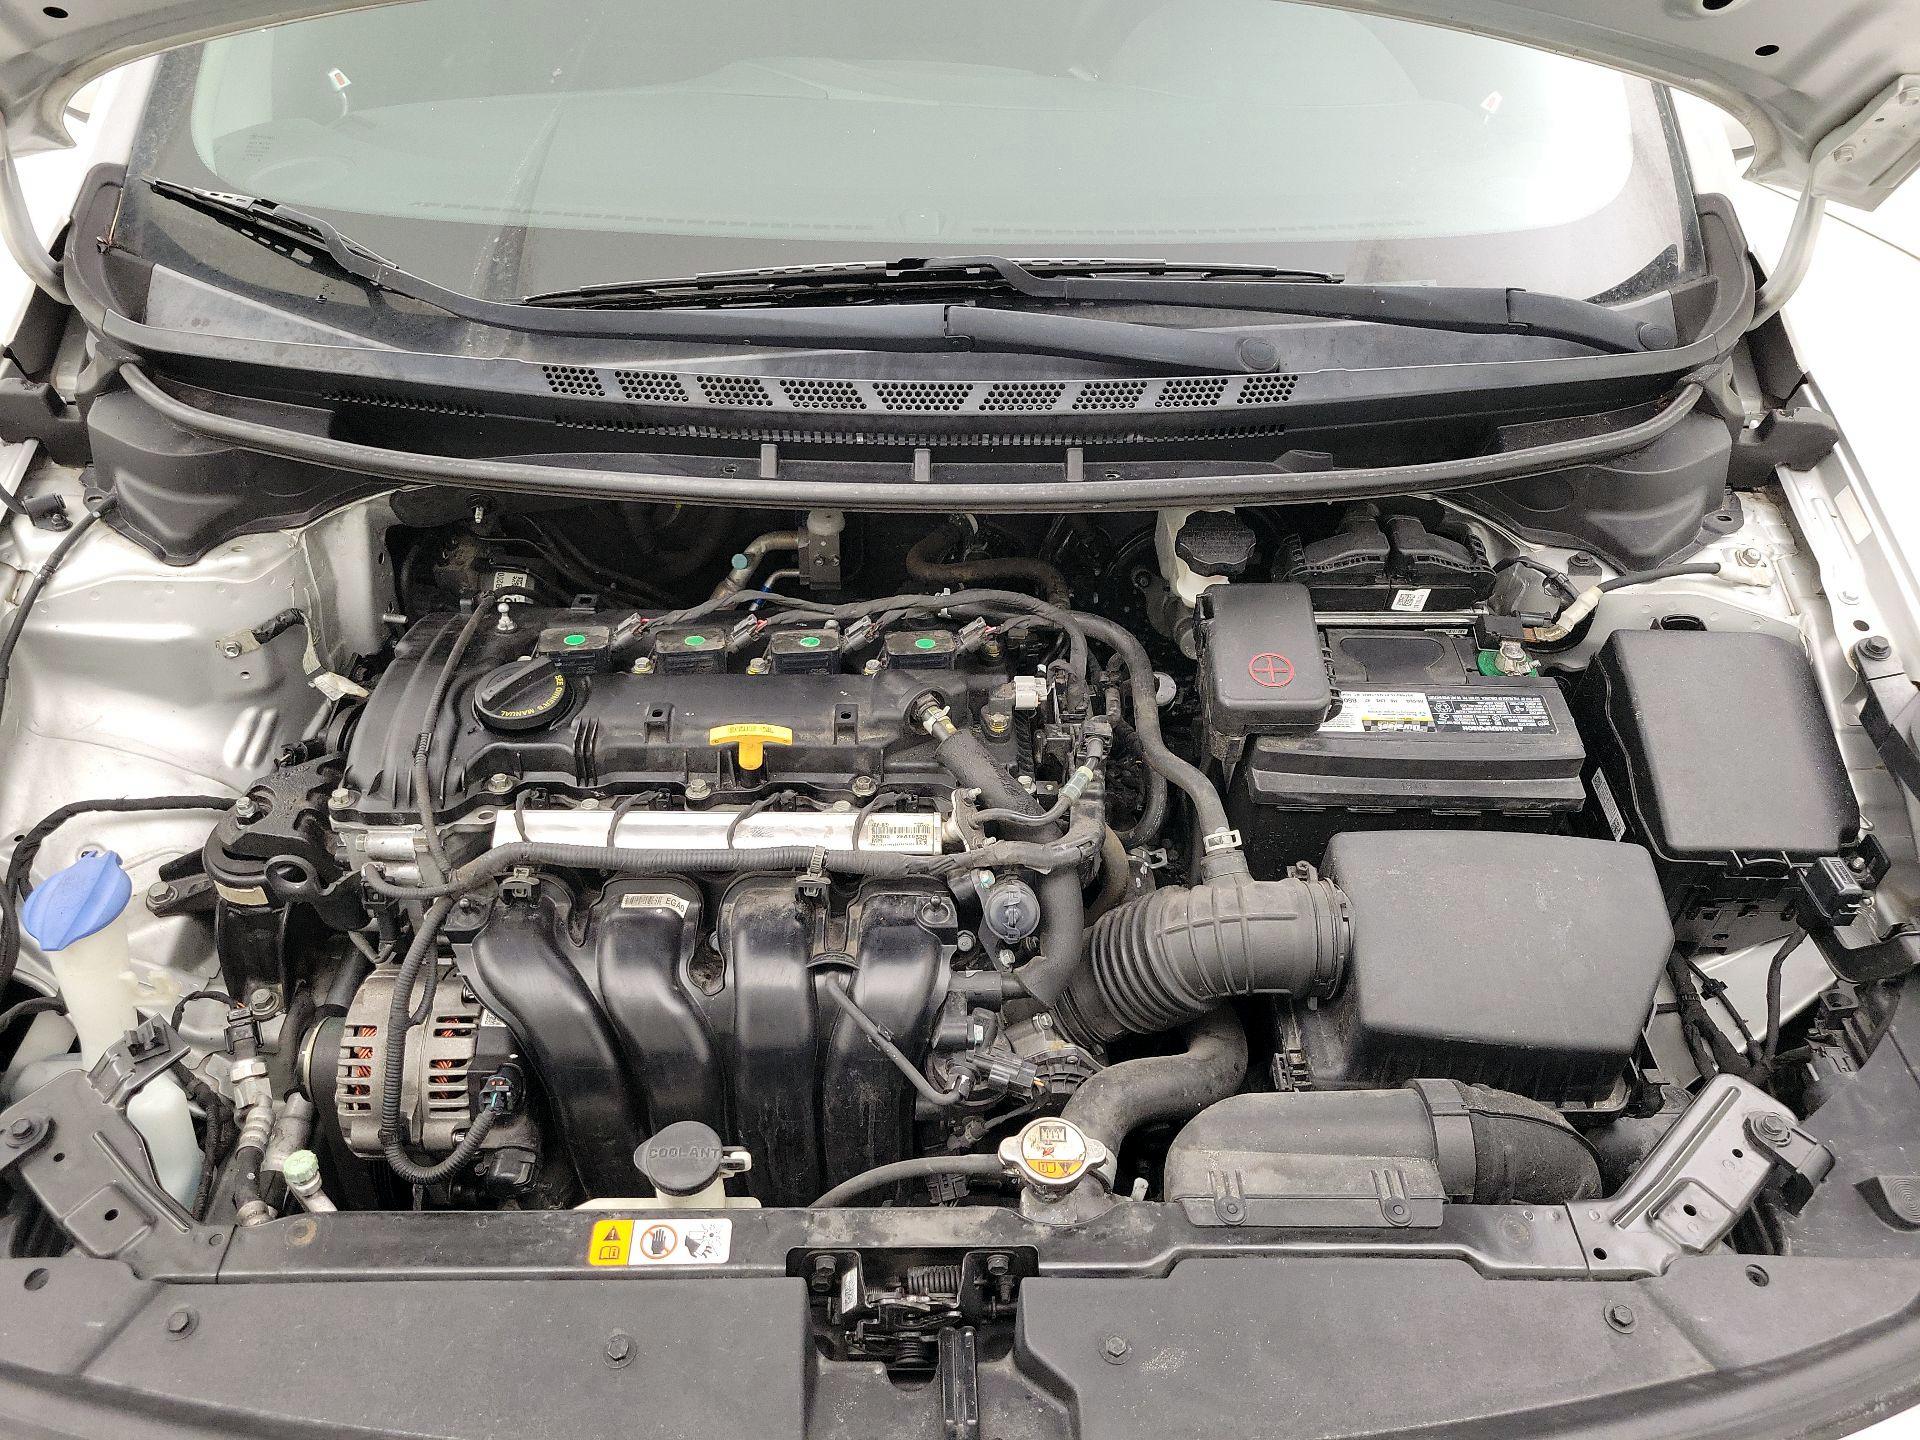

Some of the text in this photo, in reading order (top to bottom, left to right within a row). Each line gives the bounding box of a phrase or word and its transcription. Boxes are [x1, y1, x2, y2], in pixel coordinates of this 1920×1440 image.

[554, 674, 564, 686] SEE
[501, 708, 535, 717] MANUAL
[649, 1147, 719, 1158] COOLANT
